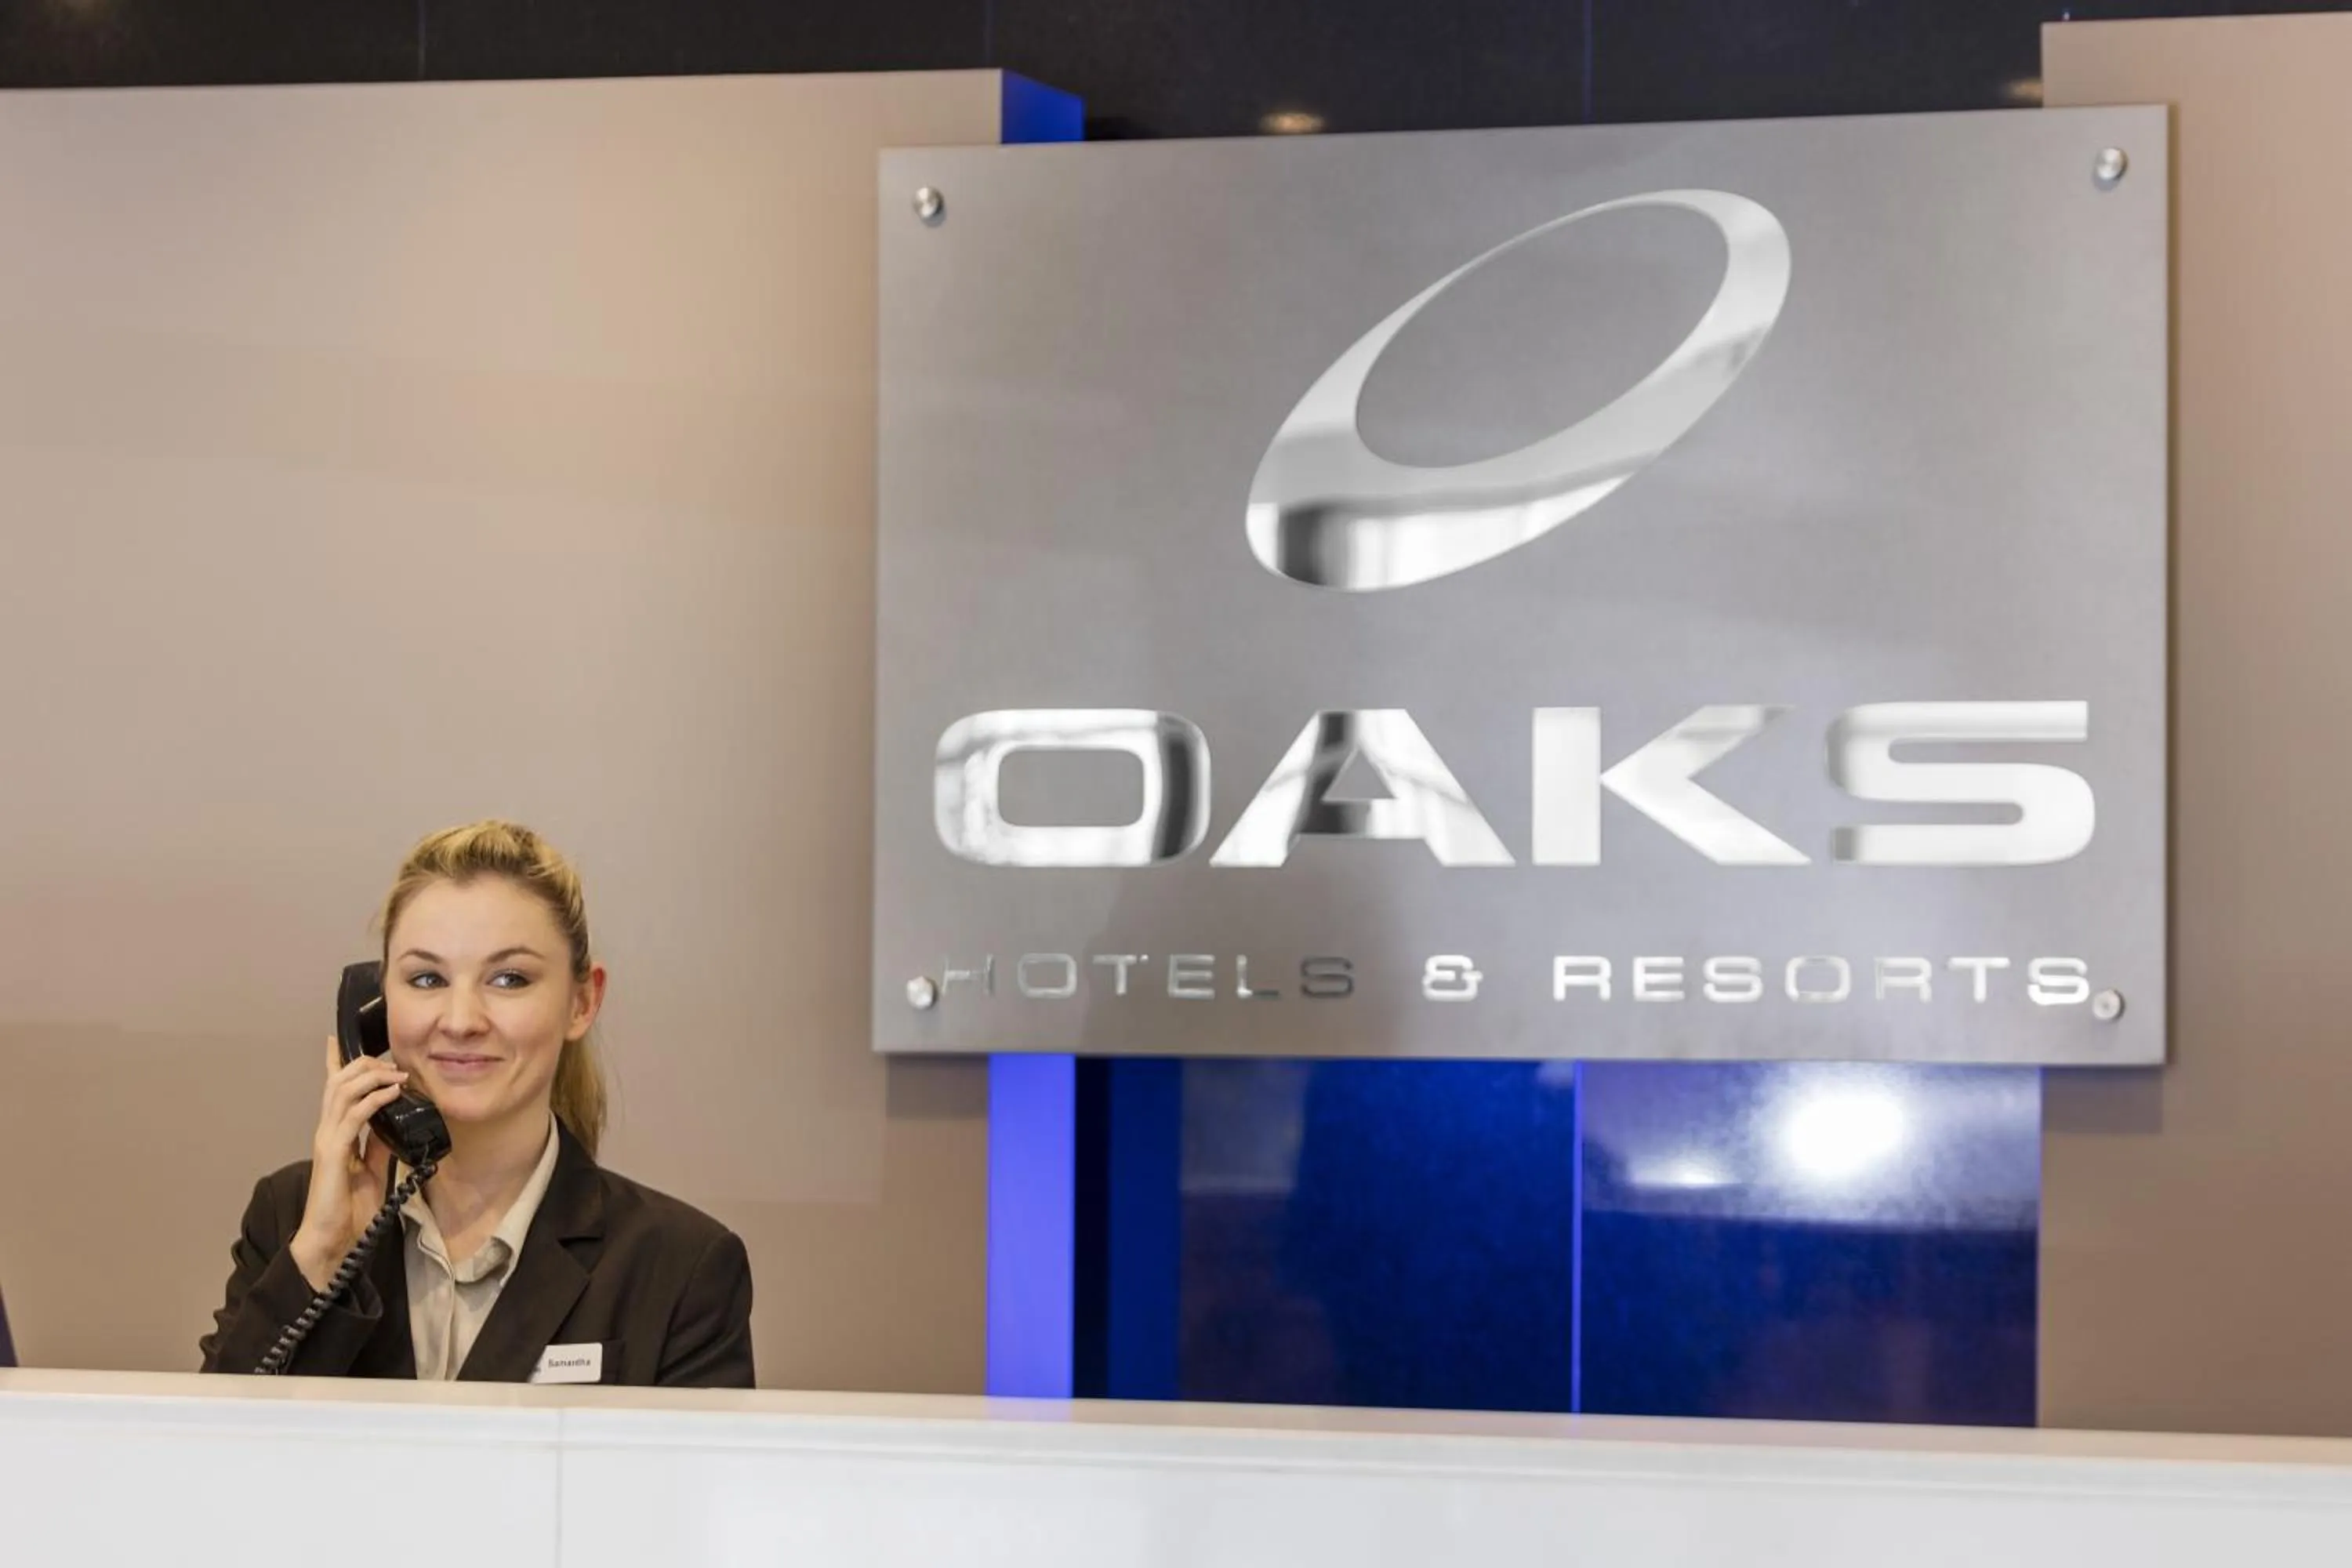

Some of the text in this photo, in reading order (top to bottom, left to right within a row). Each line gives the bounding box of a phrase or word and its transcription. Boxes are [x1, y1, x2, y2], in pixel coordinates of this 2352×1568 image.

[935, 701, 2096, 867] OAKS
[942, 953, 2090, 1006] HOTELS & RESORTS
